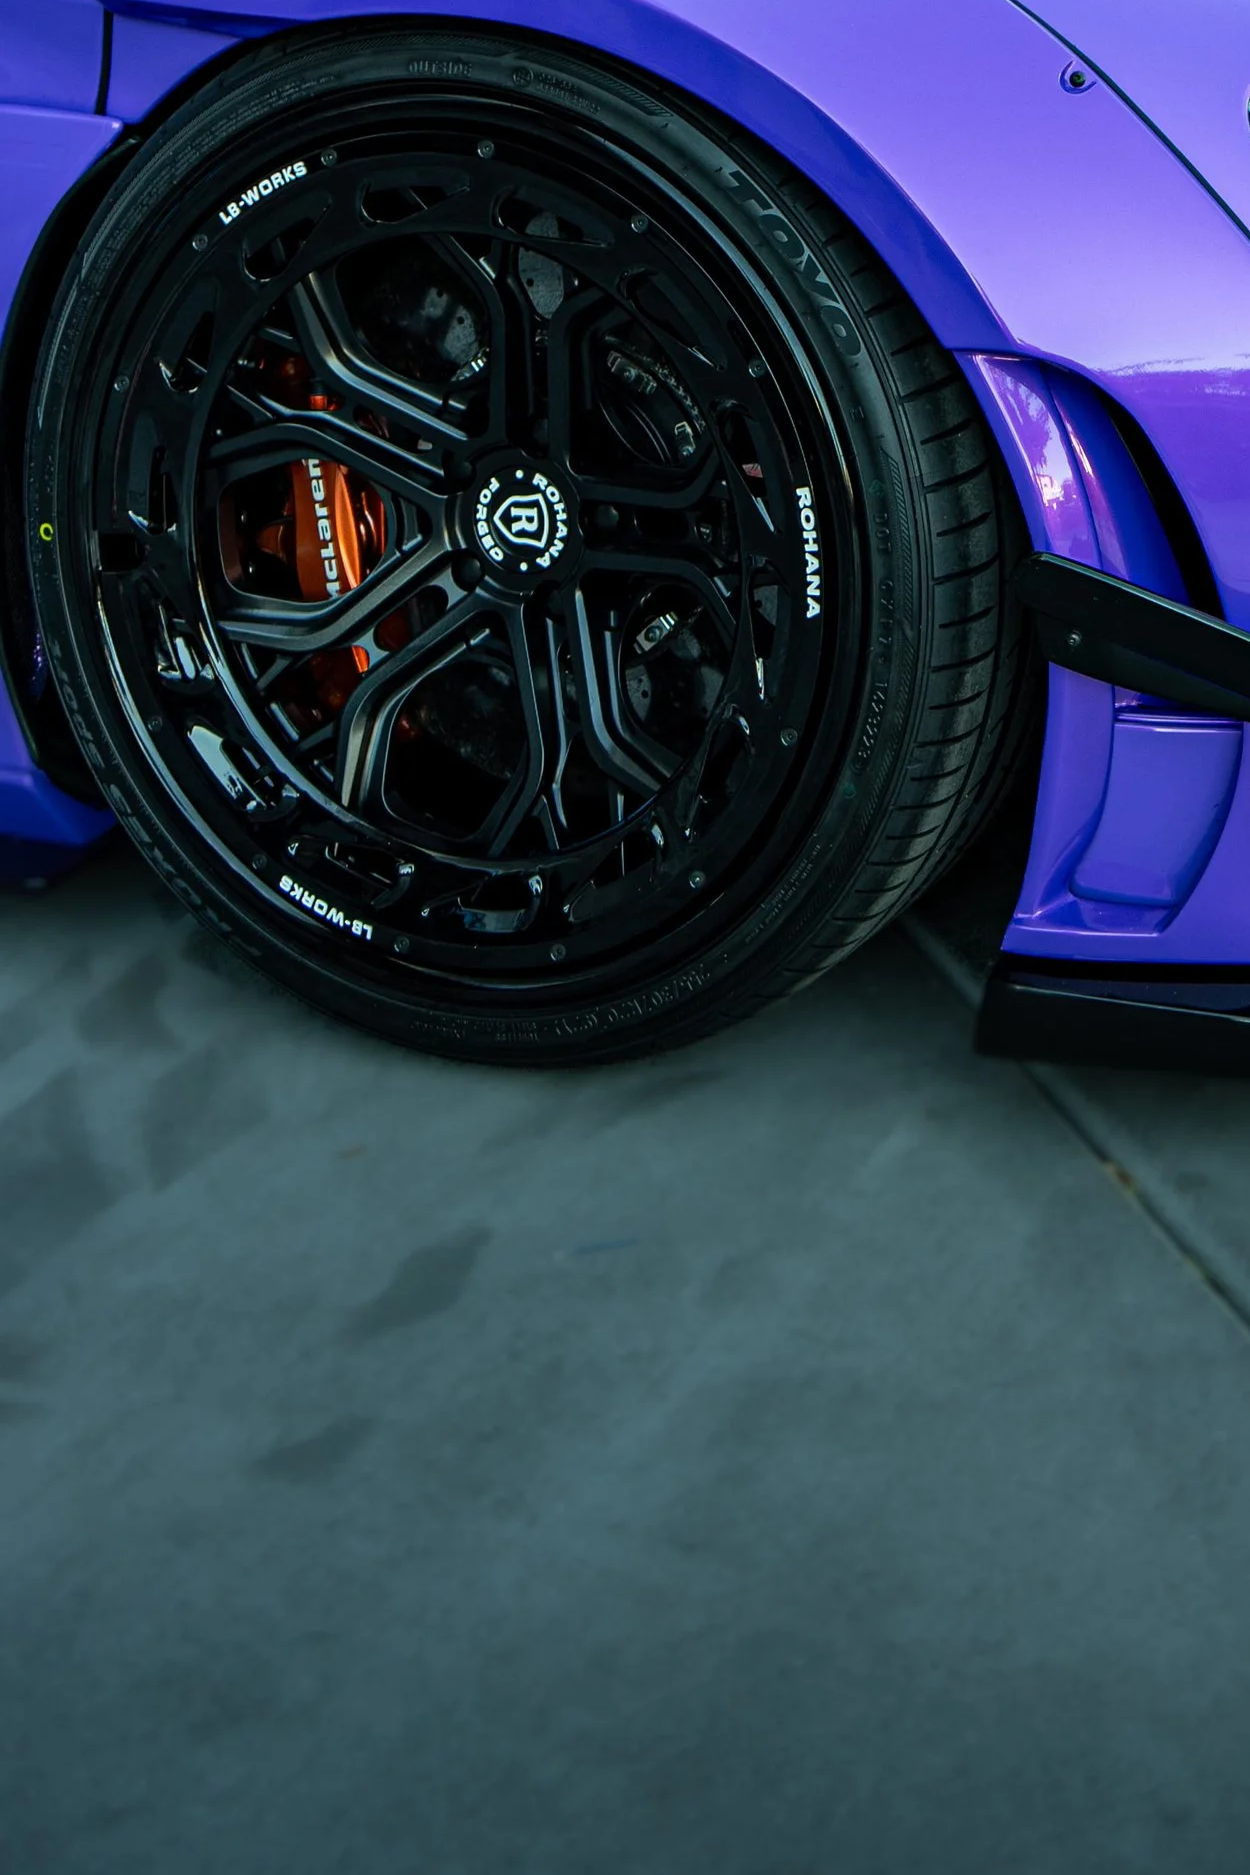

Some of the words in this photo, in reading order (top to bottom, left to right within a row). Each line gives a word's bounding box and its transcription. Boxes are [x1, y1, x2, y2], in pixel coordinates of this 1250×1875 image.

[218, 160, 308, 225] LB-WORKS
[719, 169, 864, 357] TOYO
[532, 472, 569, 569] ROHANA
[795, 486, 822, 619] ROHANA
[279, 874, 374, 940] LB-WORKS
